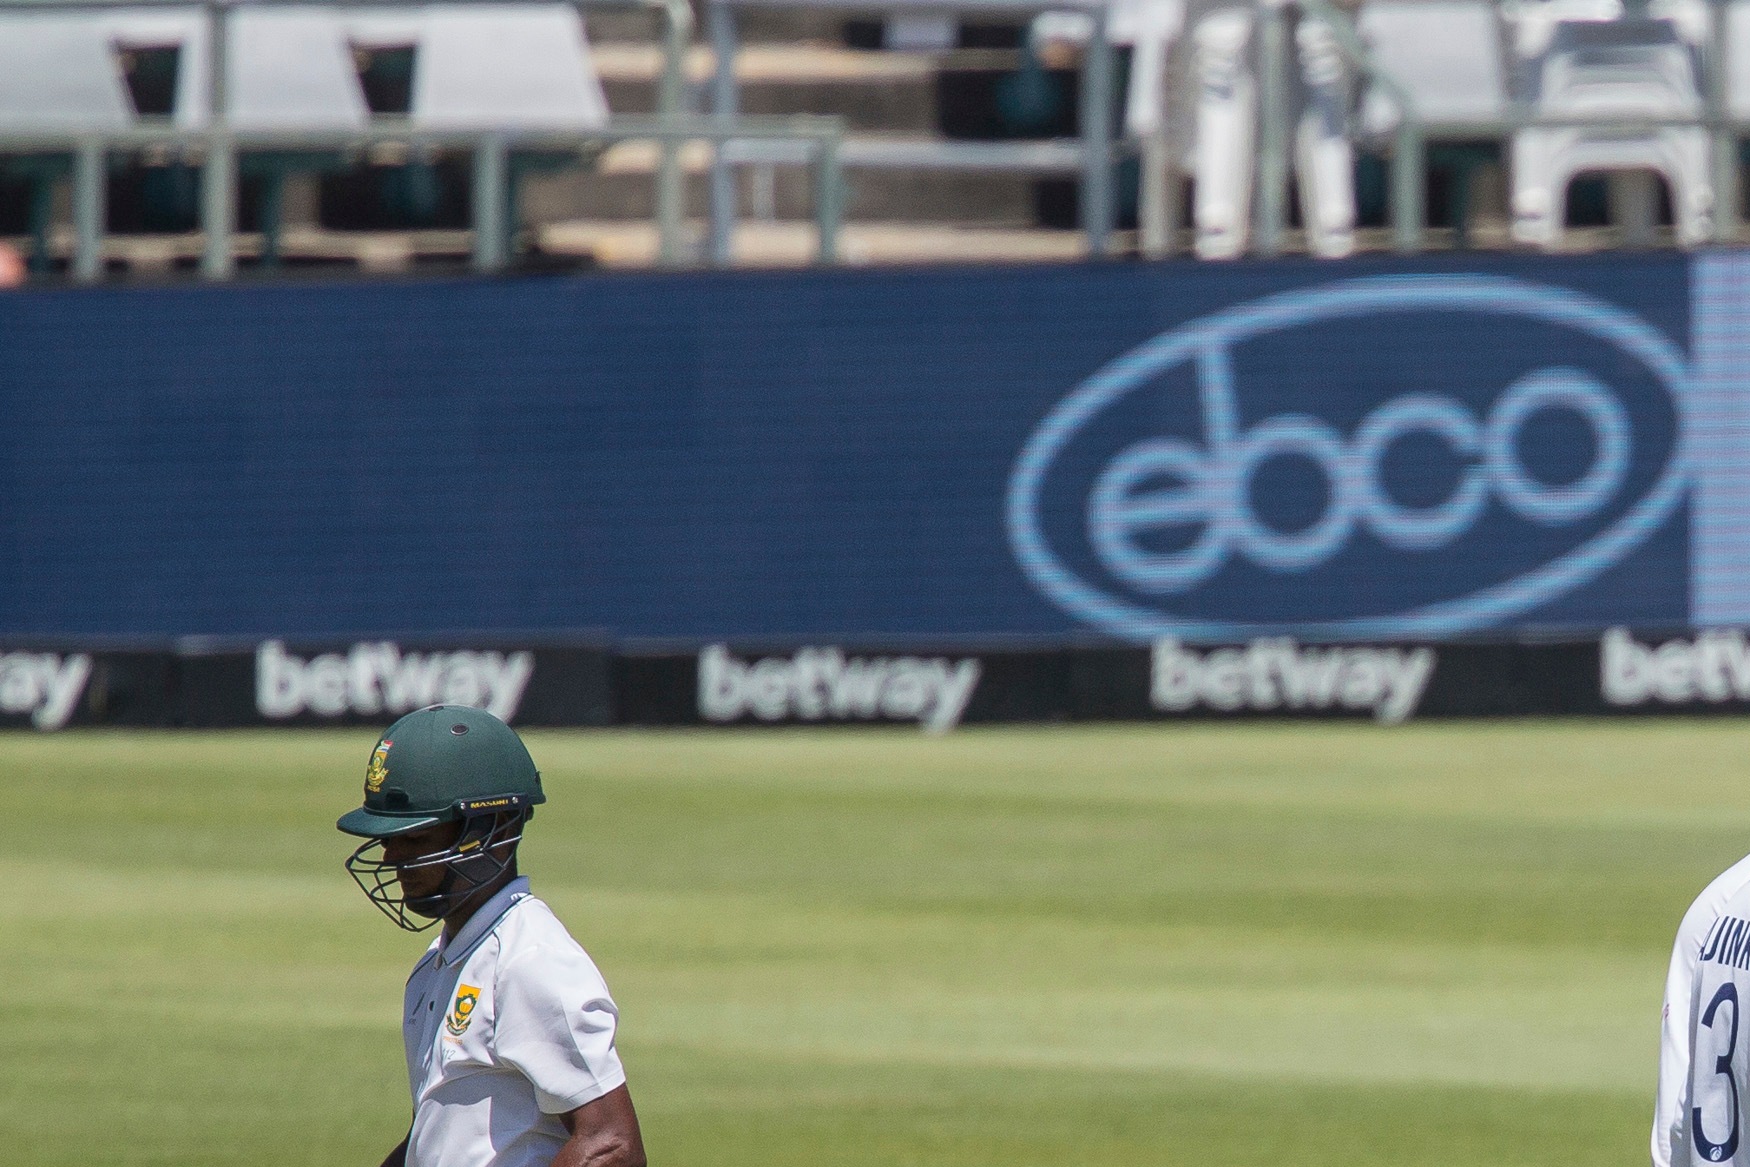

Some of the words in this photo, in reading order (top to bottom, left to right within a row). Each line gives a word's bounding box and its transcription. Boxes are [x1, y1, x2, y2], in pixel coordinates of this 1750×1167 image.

[1088, 337, 1632, 593] ebco
[255, 638, 536, 724] betway
[697, 643, 982, 734] betway
[1150, 634, 1436, 726] betway
[1691, 981, 1740, 1163] 3
